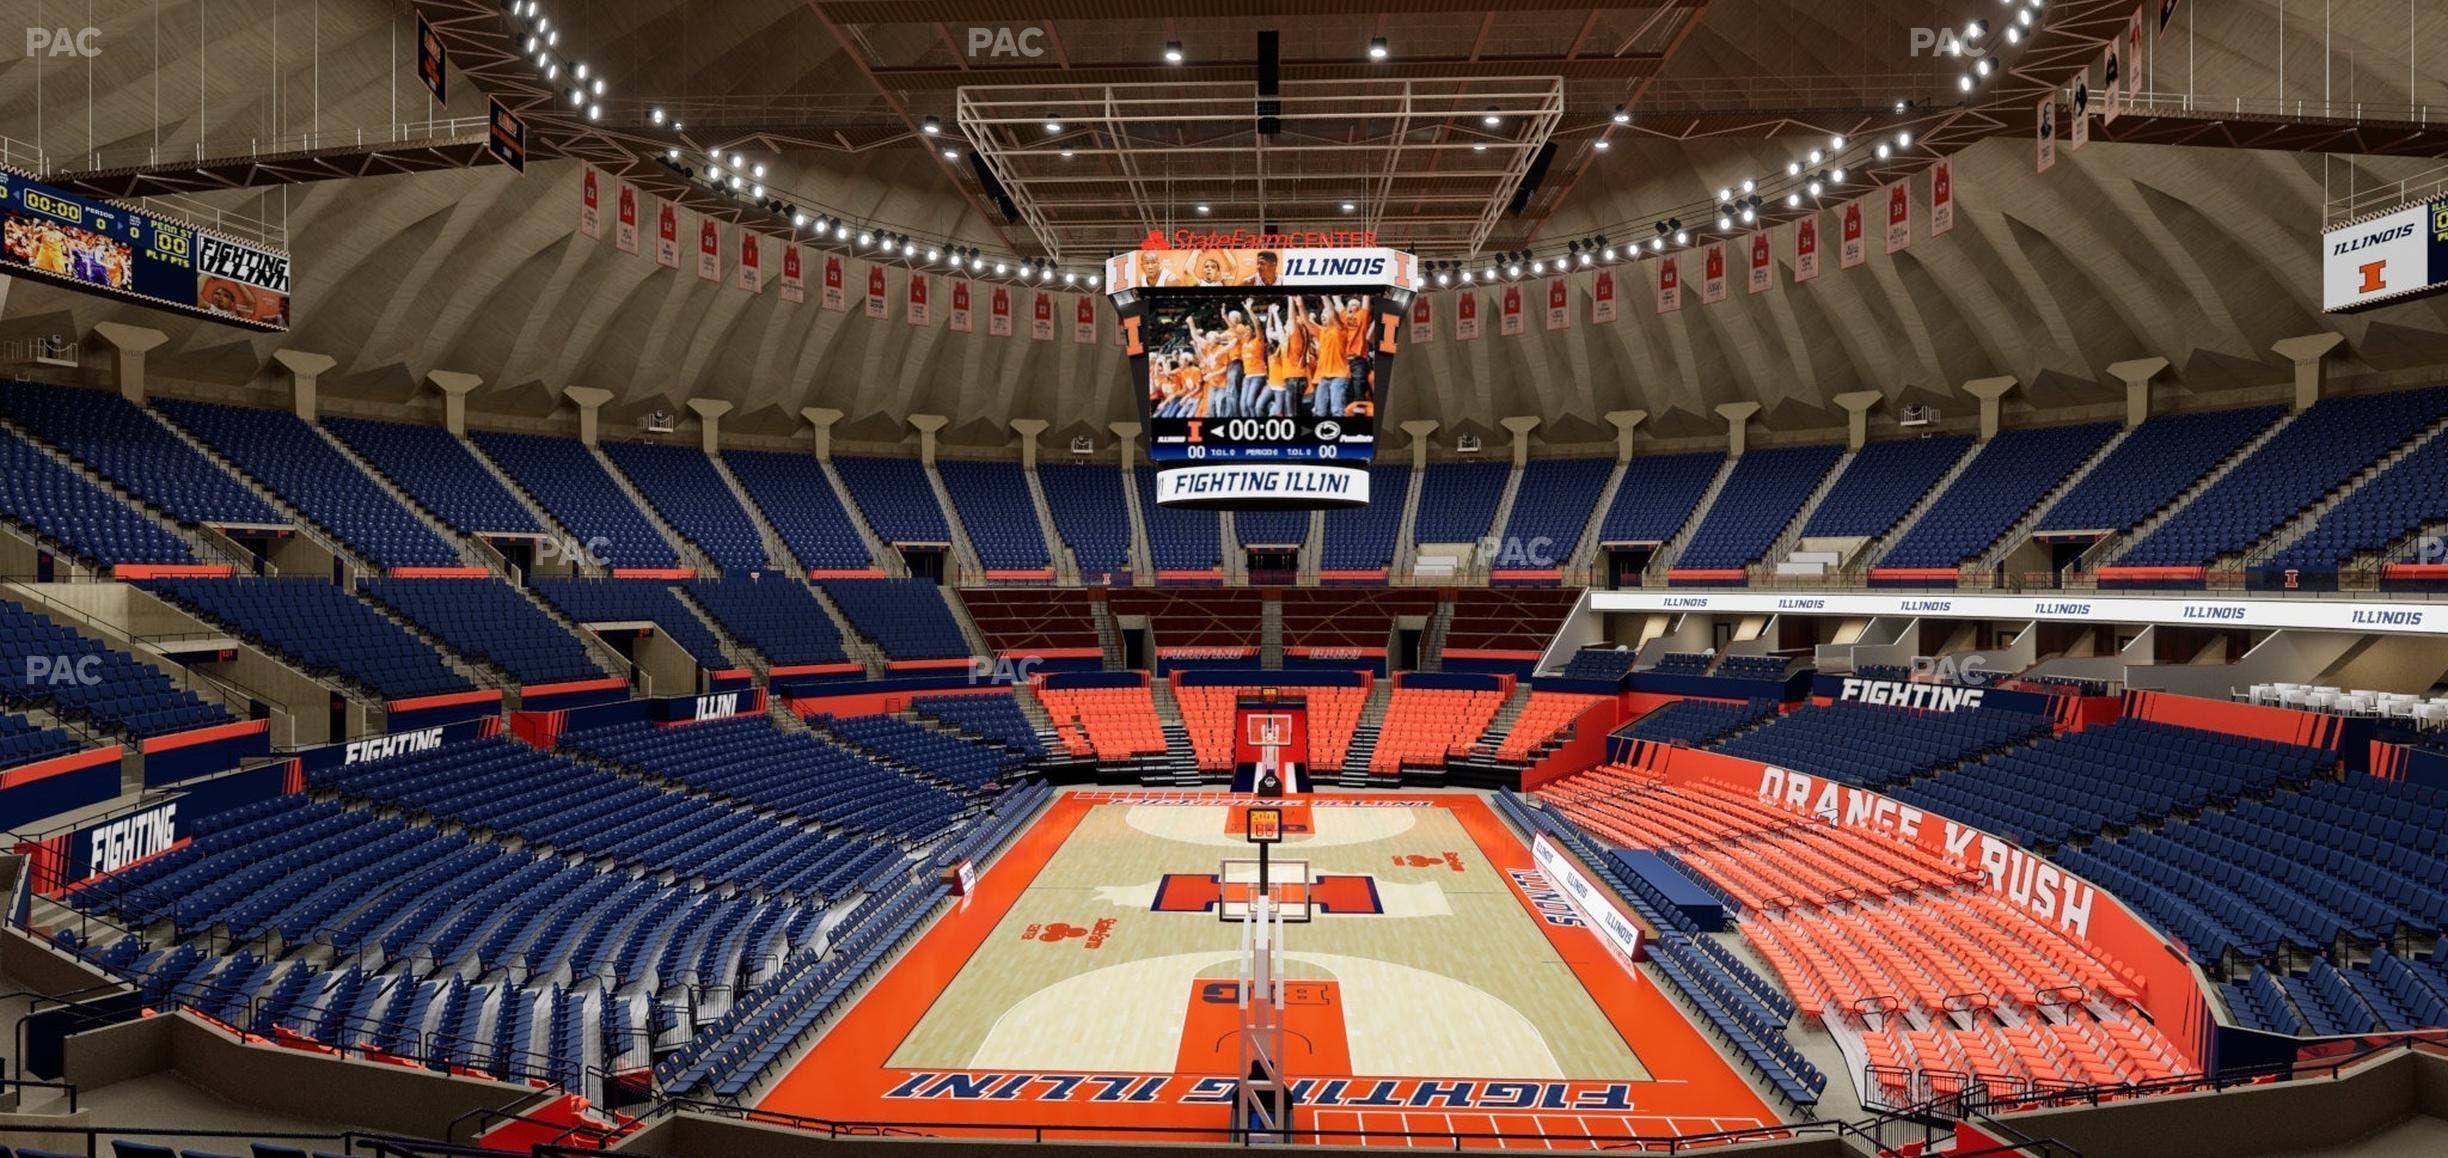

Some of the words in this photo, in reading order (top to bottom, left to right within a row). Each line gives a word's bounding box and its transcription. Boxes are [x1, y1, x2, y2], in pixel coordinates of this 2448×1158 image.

[27, 193, 79, 220] 00:00
[85, 206, 115, 219] PERIOD
[96, 218, 106, 230] 0
[130, 227, 140, 239] 0
[158, 234, 187, 255] 00
[2333, 223, 2415, 256] ILLINOIS
[202, 236, 289, 276] FIGHTING
[1285, 258, 1386, 276] ILLINOIS
[200, 252, 290, 293] ILLINI
[1229, 418, 1295, 441] 00:00
[1187, 445, 1205, 459] 00
[1318, 445, 1337, 458] 00
[1175, 472, 1279, 494] FIGHTING
[1285, 472, 1350, 493] ILLINI
[1663, 597, 1708, 608] ILLINOIS
[1778, 599, 1824, 609] ILLINOIS
[1900, 600, 1951, 611] ILLINOIS
[2034, 602, 2091, 615] ILLINOIS
[2183, 606, 2246, 619] ILLINOIS
[2352, 610, 2423, 626] ILLINOIS
[1840, 678, 1984, 713] FIGHTING
[695, 693, 738, 721] ILLINI
[345, 727, 443, 766] FIGHTING
[90, 803, 176, 880] FIGHTING
[1758, 766, 1922, 850] ORANGE
[1942, 821, 2094, 944] KRUSH
[1566, 872, 1588, 899] ILLINOIS
[1605, 911, 1634, 945] ILLINOIS
[881, 1071, 1176, 1104] ILLINI
